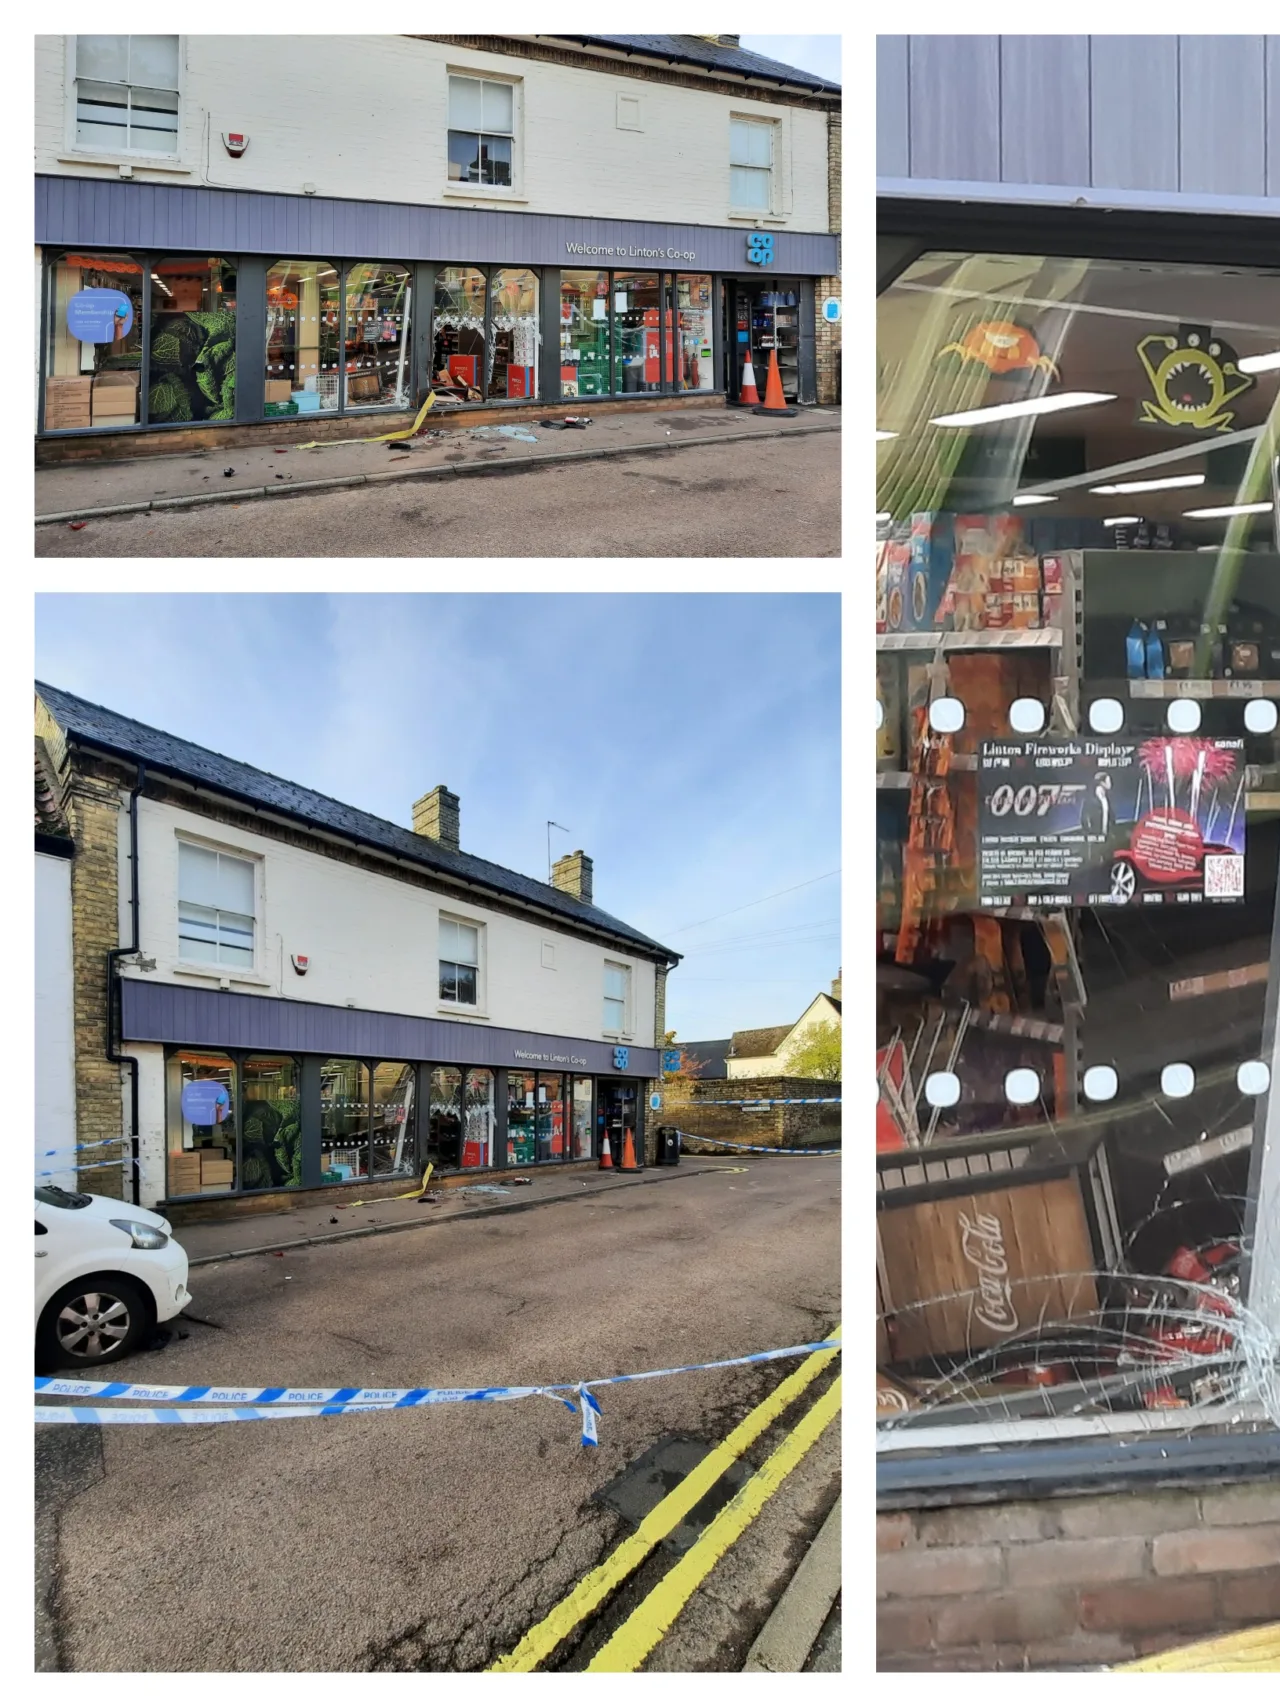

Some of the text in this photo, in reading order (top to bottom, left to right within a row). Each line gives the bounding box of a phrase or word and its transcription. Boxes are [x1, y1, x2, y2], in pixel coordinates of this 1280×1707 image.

[565, 242, 696, 262] Welcome to Linton's Co-op
[983, 742, 1135, 758] Linton Fireworks Display
[991, 784, 1072, 817] 007
[514, 1049, 587, 1066] Welcome to Linton's Co-op
[51, 1383, 92, 1394] POLICE
[132, 1389, 169, 1399] POLICE
[211, 1392, 248, 1401] POLICE
[288, 1392, 324, 1401] POLICE
[363, 1391, 398, 1399] POLICE
